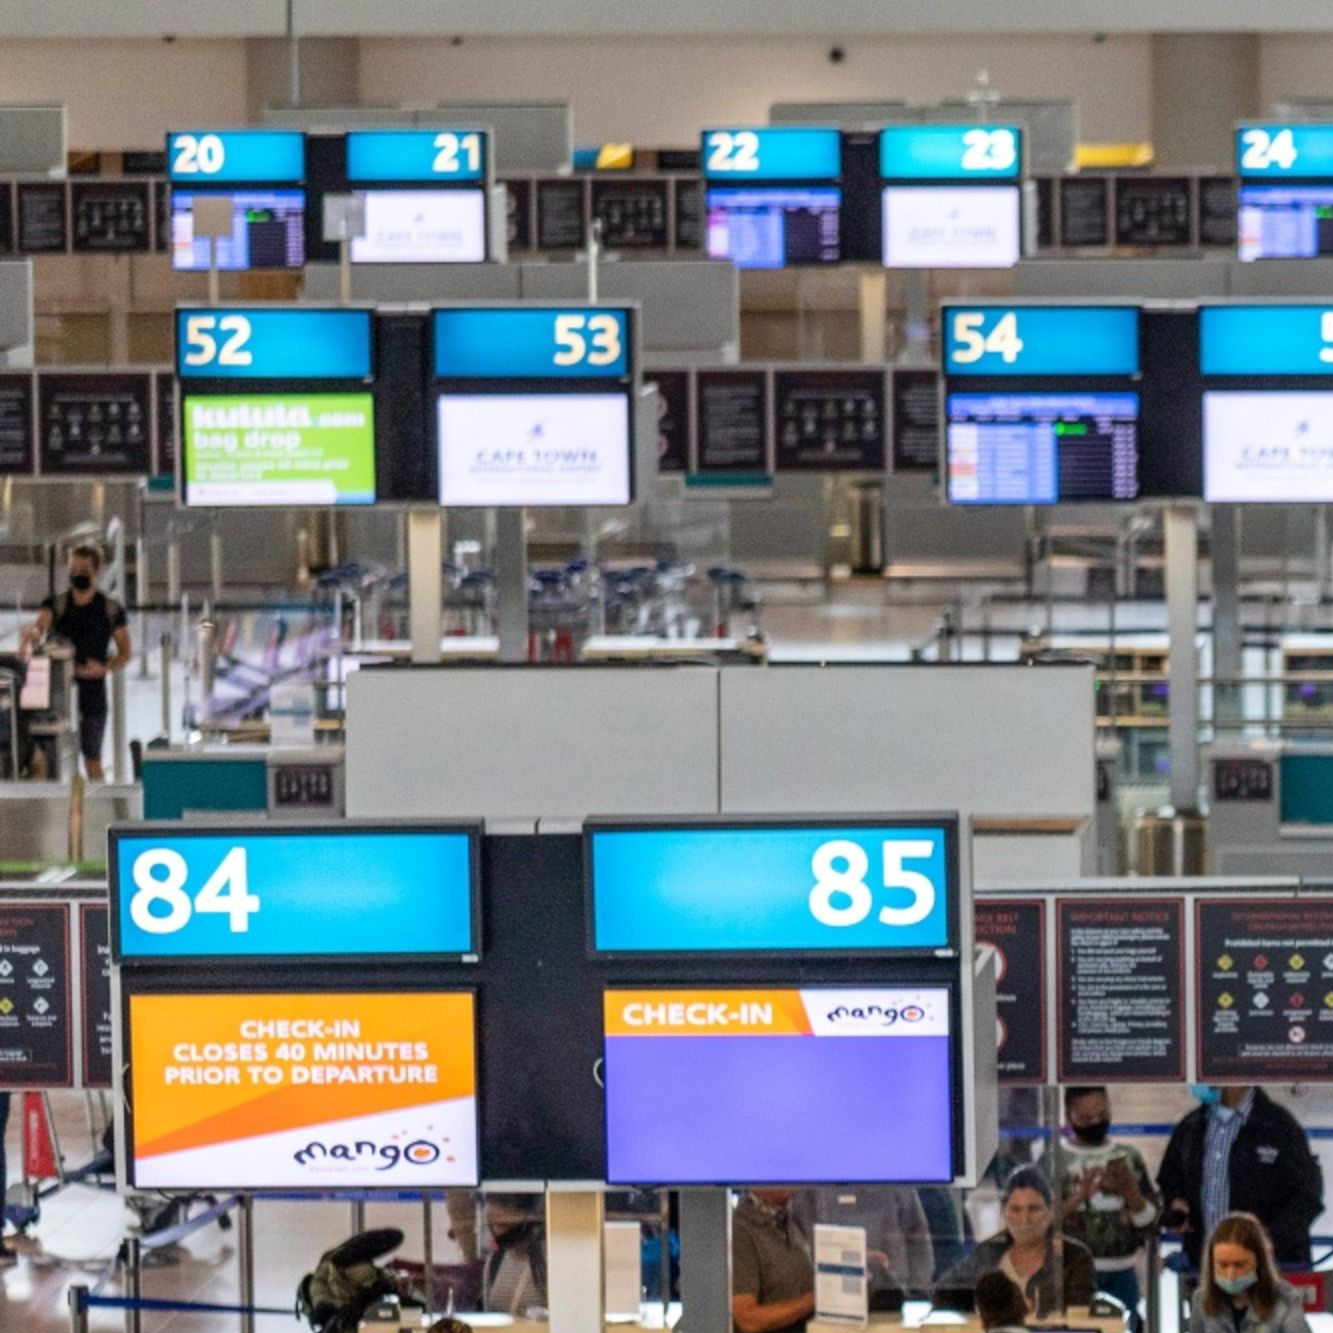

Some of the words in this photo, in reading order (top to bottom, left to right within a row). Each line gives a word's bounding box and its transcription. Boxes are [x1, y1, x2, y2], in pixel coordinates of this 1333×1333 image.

[174, 135, 224, 173] 20
[434, 133, 479, 171] 21
[709, 131, 758, 170] 22
[962, 130, 1015, 169] 23
[1243, 130, 1296, 168] 24
[186, 316, 251, 364] 52
[555, 316, 620, 365] 53
[954, 314, 1023, 362] 54
[193, 432, 237, 452] bag
[244, 430, 301, 450] drop
[132, 848, 259, 932] 84
[810, 841, 934, 925] 85
[240, 1021, 360, 1038] CHECK-IN
[622, 1003, 774, 1026] CHECK-IN
[826, 1002, 926, 1026] mango
[173, 1044, 268, 1062] CLOSES
[275, 1044, 305, 1061] 40
[314, 1043, 428, 1062] MINUTES
[164, 1066, 240, 1086] PRIOR
[248, 1066, 284, 1085] TO
[292, 1065, 438, 1085] DEPARTURE
[294, 1139, 440, 1171] mango
